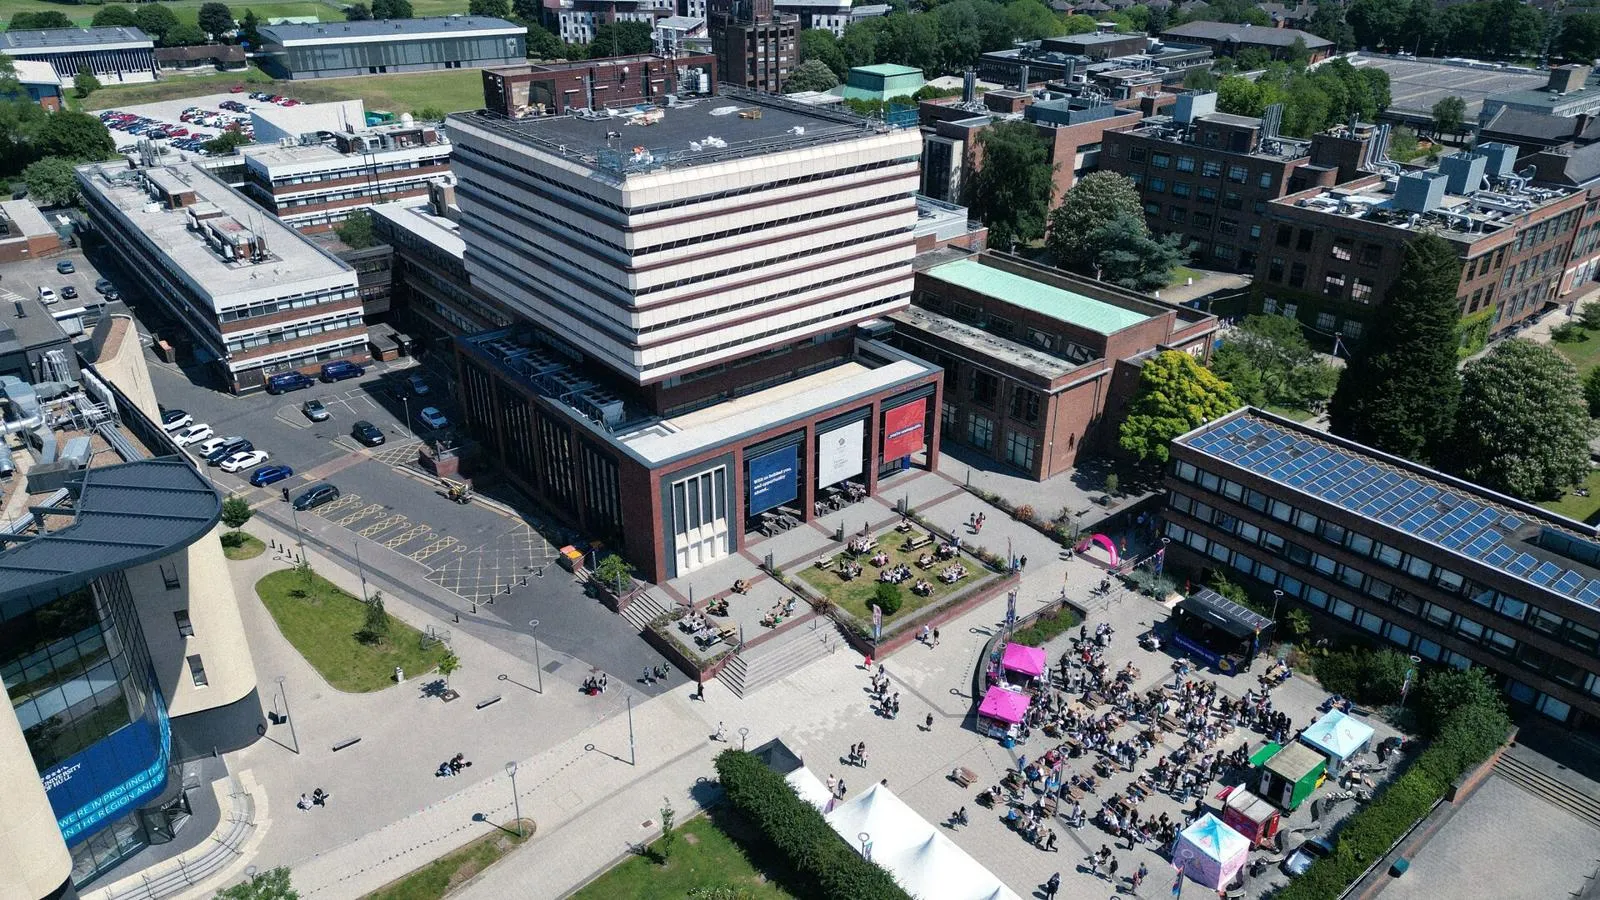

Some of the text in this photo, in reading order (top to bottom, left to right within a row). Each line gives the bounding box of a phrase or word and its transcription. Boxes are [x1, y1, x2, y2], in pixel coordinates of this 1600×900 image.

[91, 774, 145, 809] IMPROVING
[63, 828, 75, 839] IN
[76, 816, 95, 830] THE
[98, 791, 135, 818] REGION
